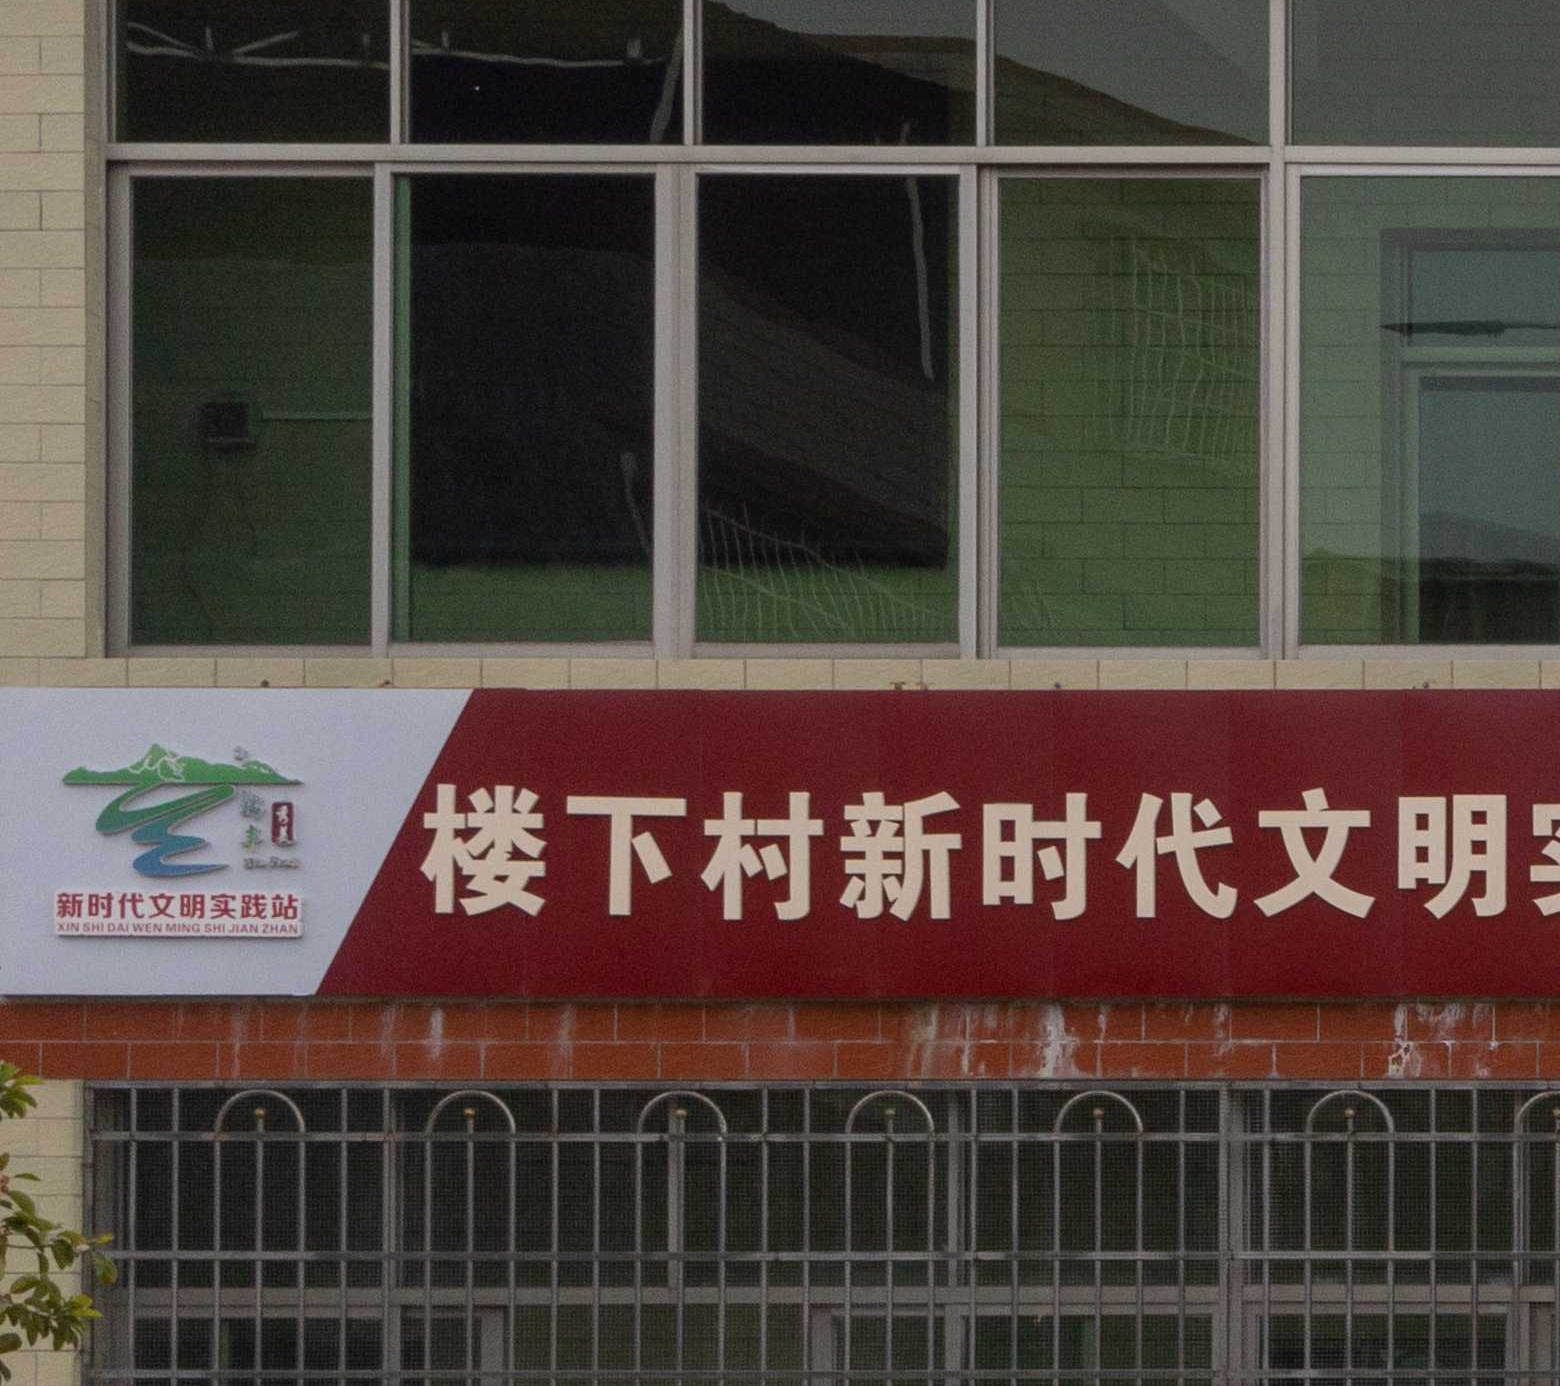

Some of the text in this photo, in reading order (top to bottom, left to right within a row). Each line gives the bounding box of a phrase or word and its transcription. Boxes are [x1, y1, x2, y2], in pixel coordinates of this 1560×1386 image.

[57, 892, 299, 920] 新时代文明实践站
[57, 922, 299, 934] XIN SHI DAI WEN MING SHI JIAN ZHAN
